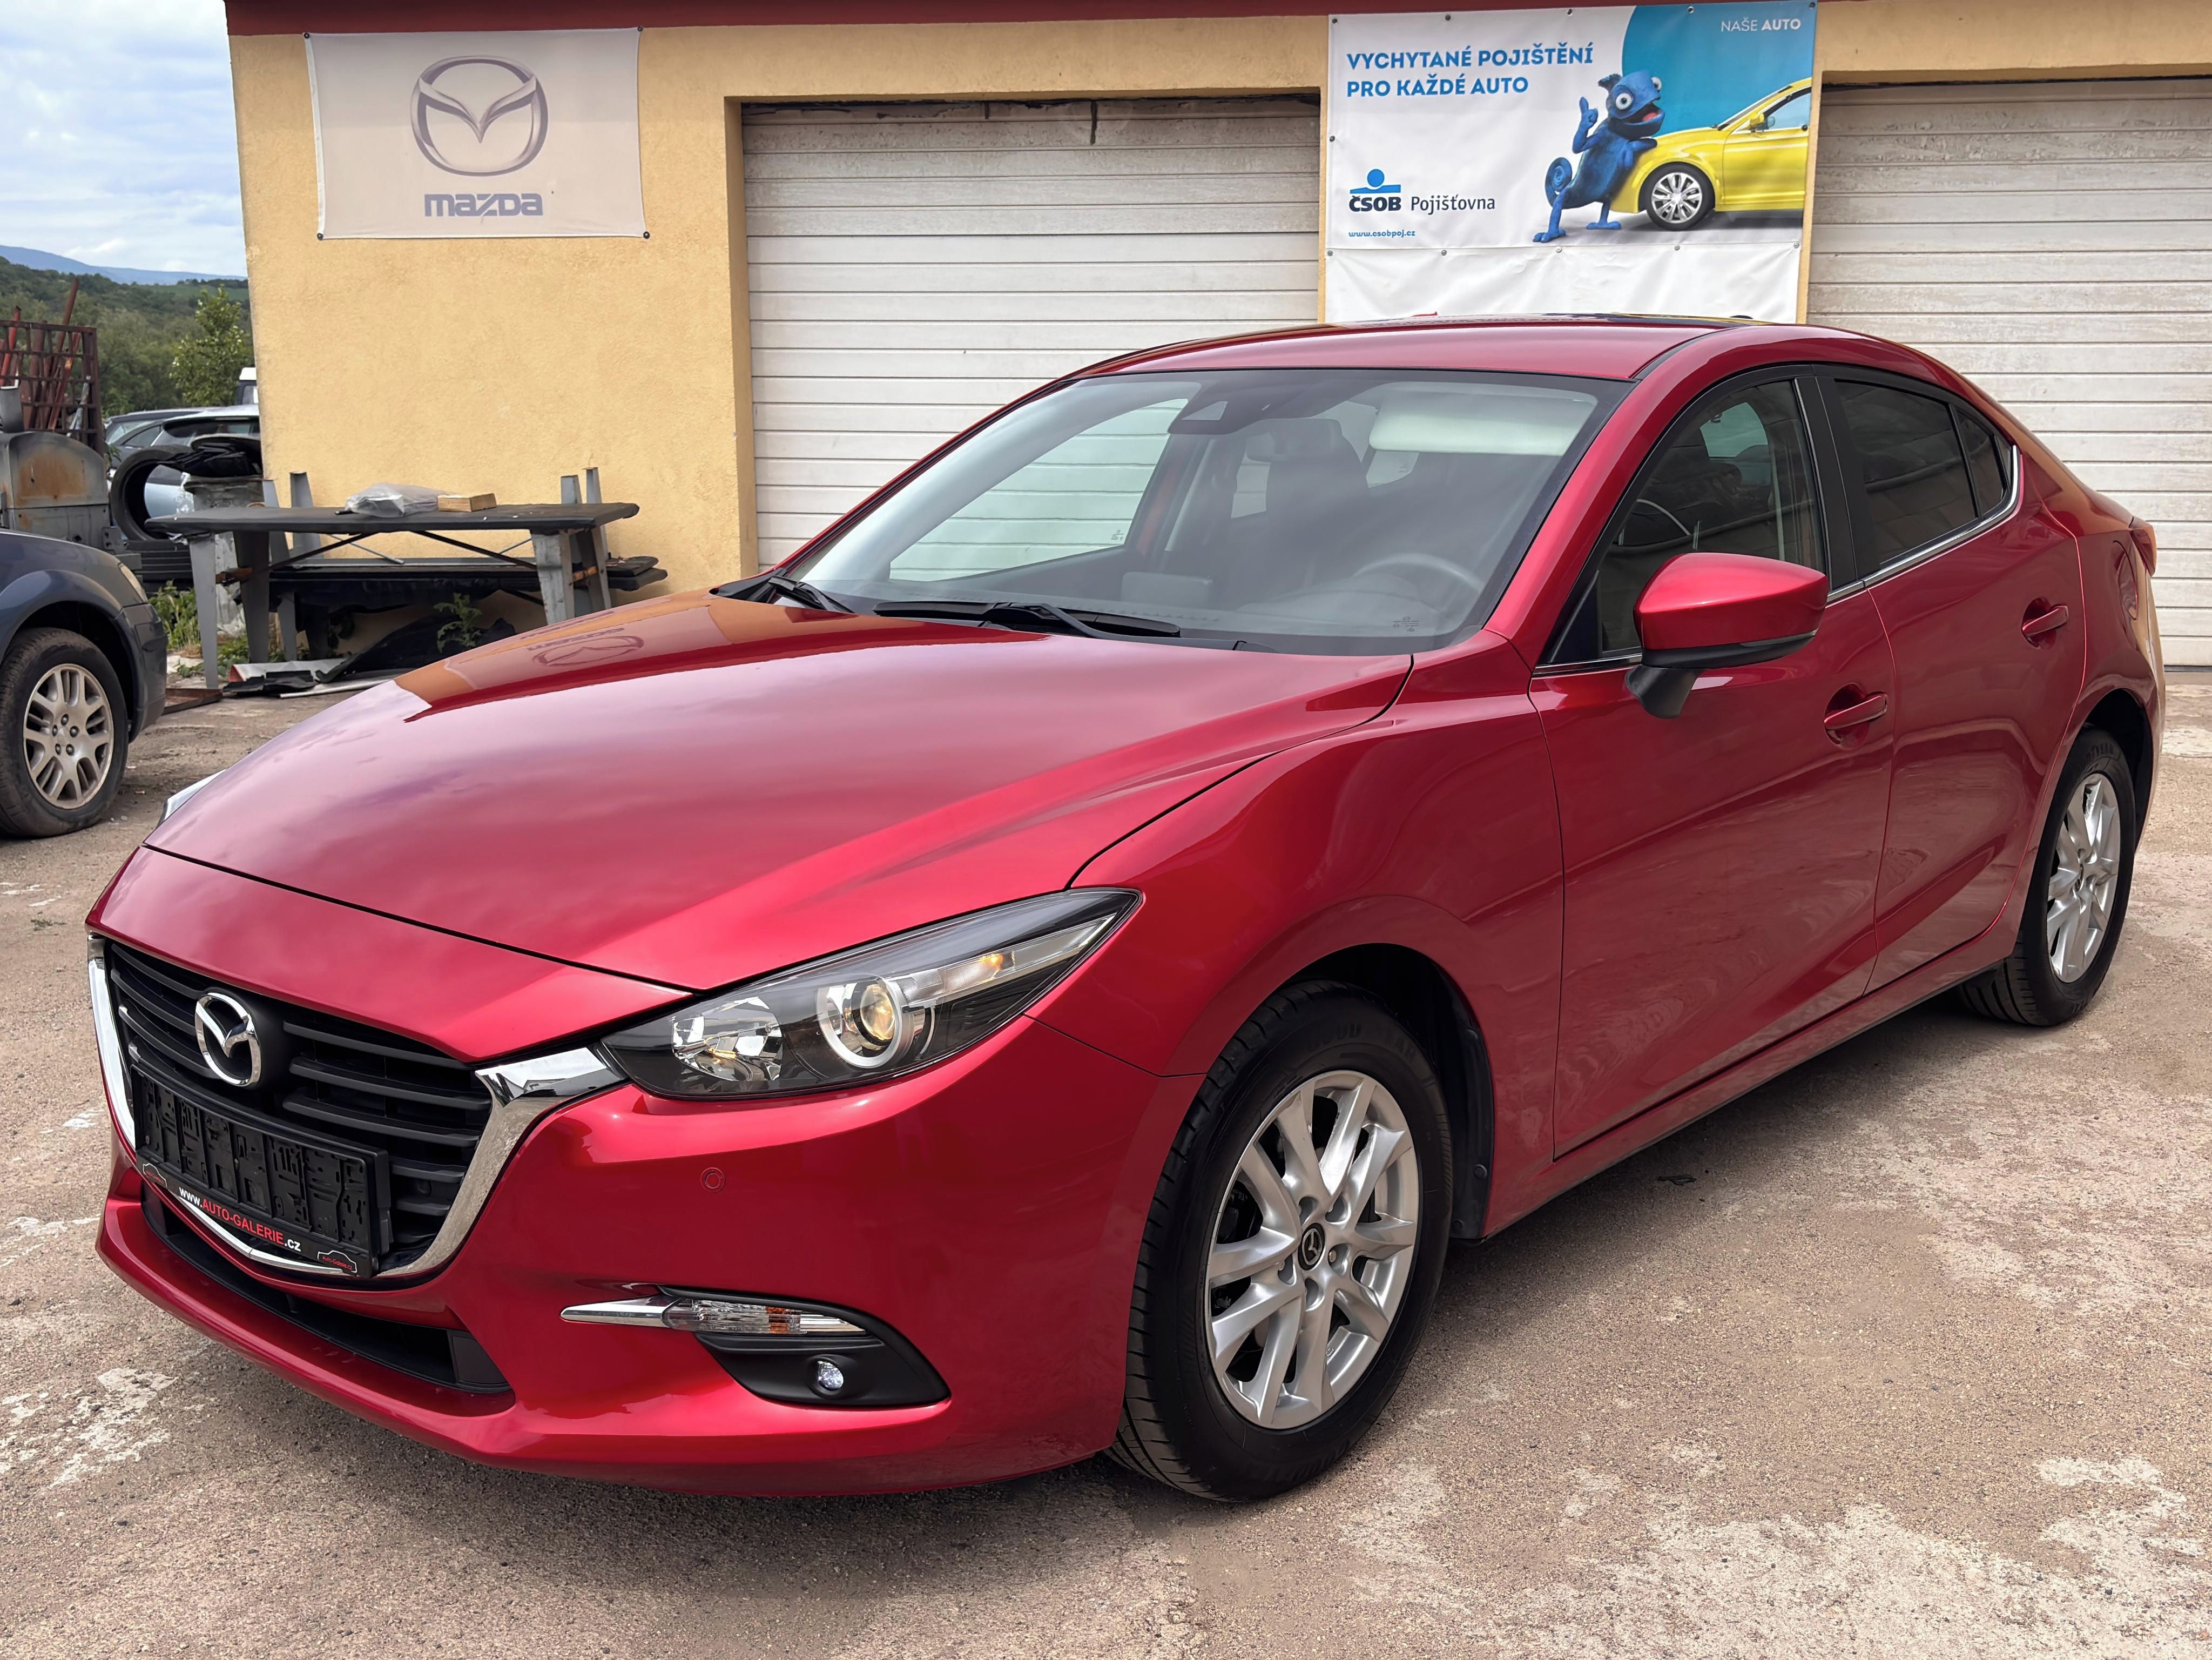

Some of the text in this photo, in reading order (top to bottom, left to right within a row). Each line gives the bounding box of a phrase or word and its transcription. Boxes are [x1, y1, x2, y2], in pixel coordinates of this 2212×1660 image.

[1721, 17, 1801, 32] NAŠE AUTO
[1346, 42, 1594, 70] VYCHYTANÉ POJIŠTĚNÍ
[1347, 73, 1529, 97] PRO KAŽDÉ AUTO
[1349, 194, 1496, 216] ČSOB Pojišťovna
[1348, 229, 1416, 238] www.csobpoj.cz
